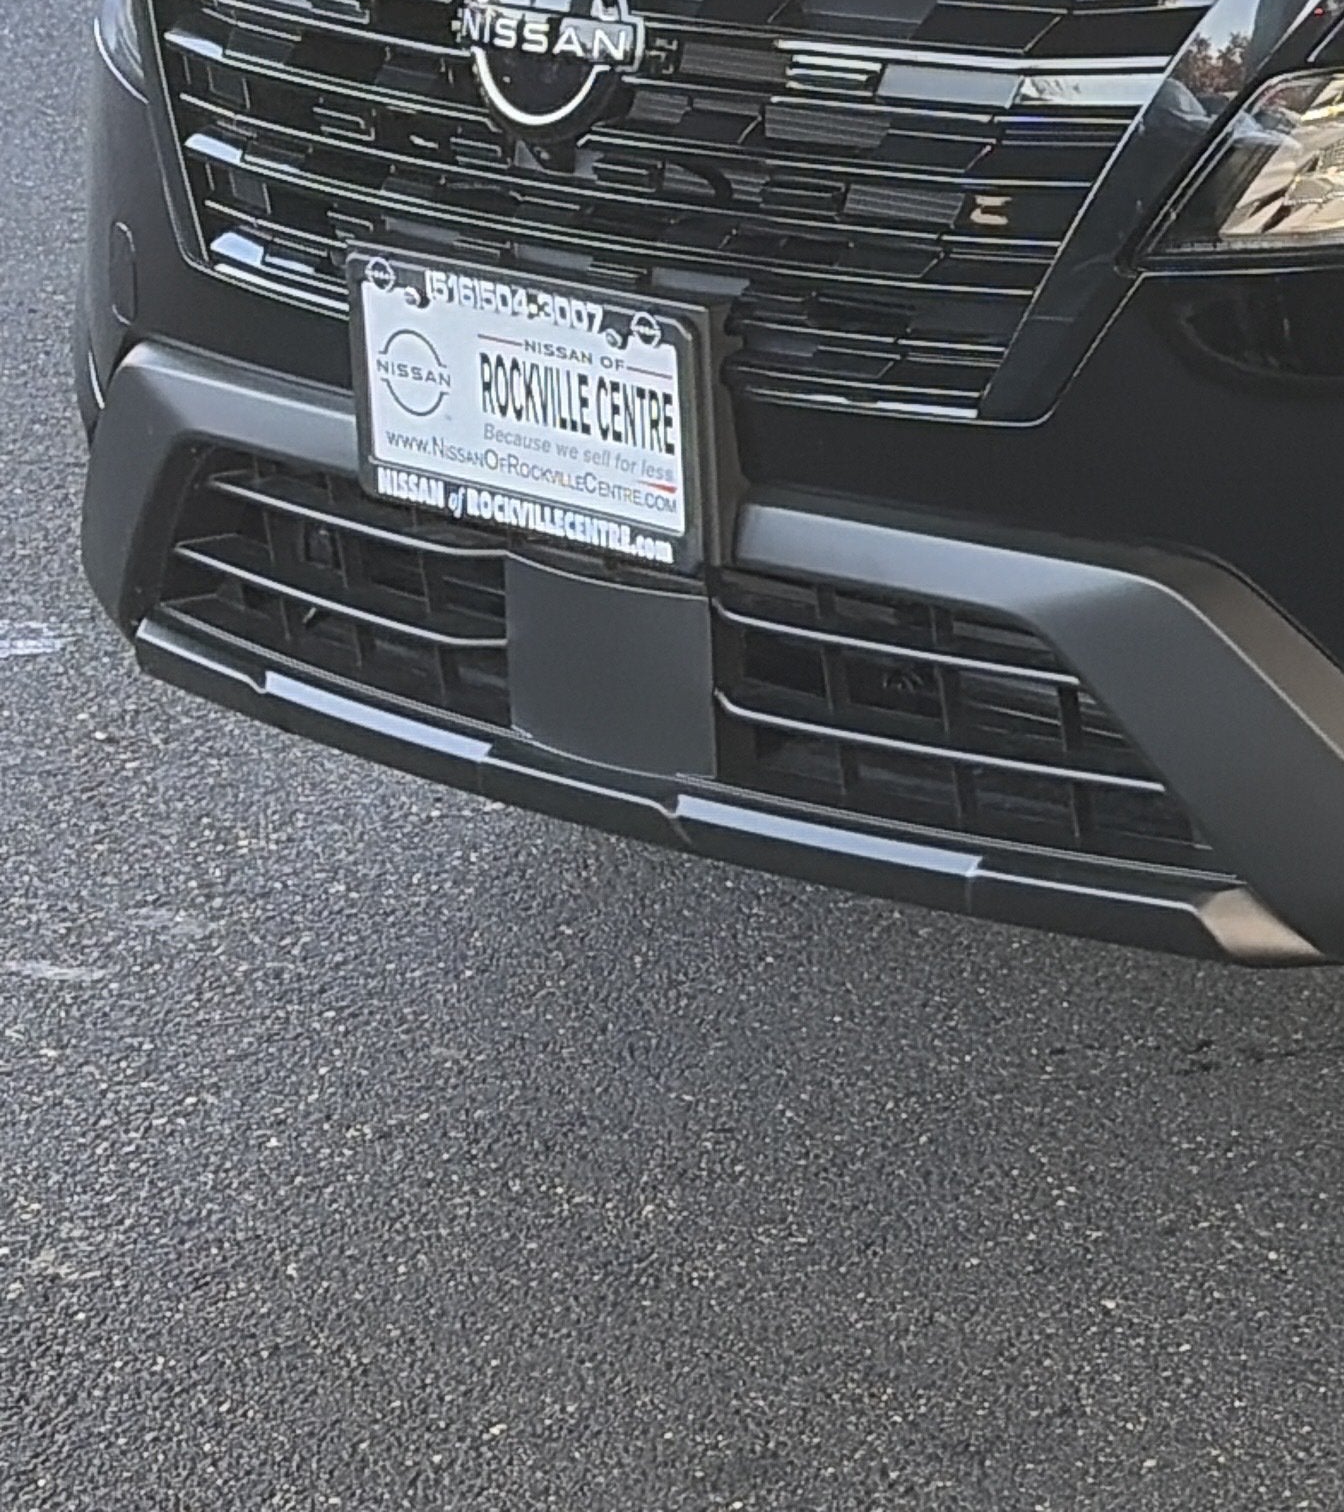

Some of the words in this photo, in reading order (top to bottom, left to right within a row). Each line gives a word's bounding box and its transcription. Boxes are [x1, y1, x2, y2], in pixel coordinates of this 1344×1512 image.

[462, 7, 627, 61] NISSAN
[376, 359, 451, 388] NISSAN
[524, 338, 593, 365] NISSAN
[600, 355, 626, 371] OF
[479, 352, 592, 436] ROCKVILLE
[597, 375, 675, 456] CENTRE
[484, 423, 551, 454] Because
[555, 443, 579, 461] we
[583, 449, 611, 468] sell
[615, 453, 637, 475] for
[641, 459, 674, 483] less
[377, 466, 445, 508] NISSAN
[448, 486, 466, 519] of
